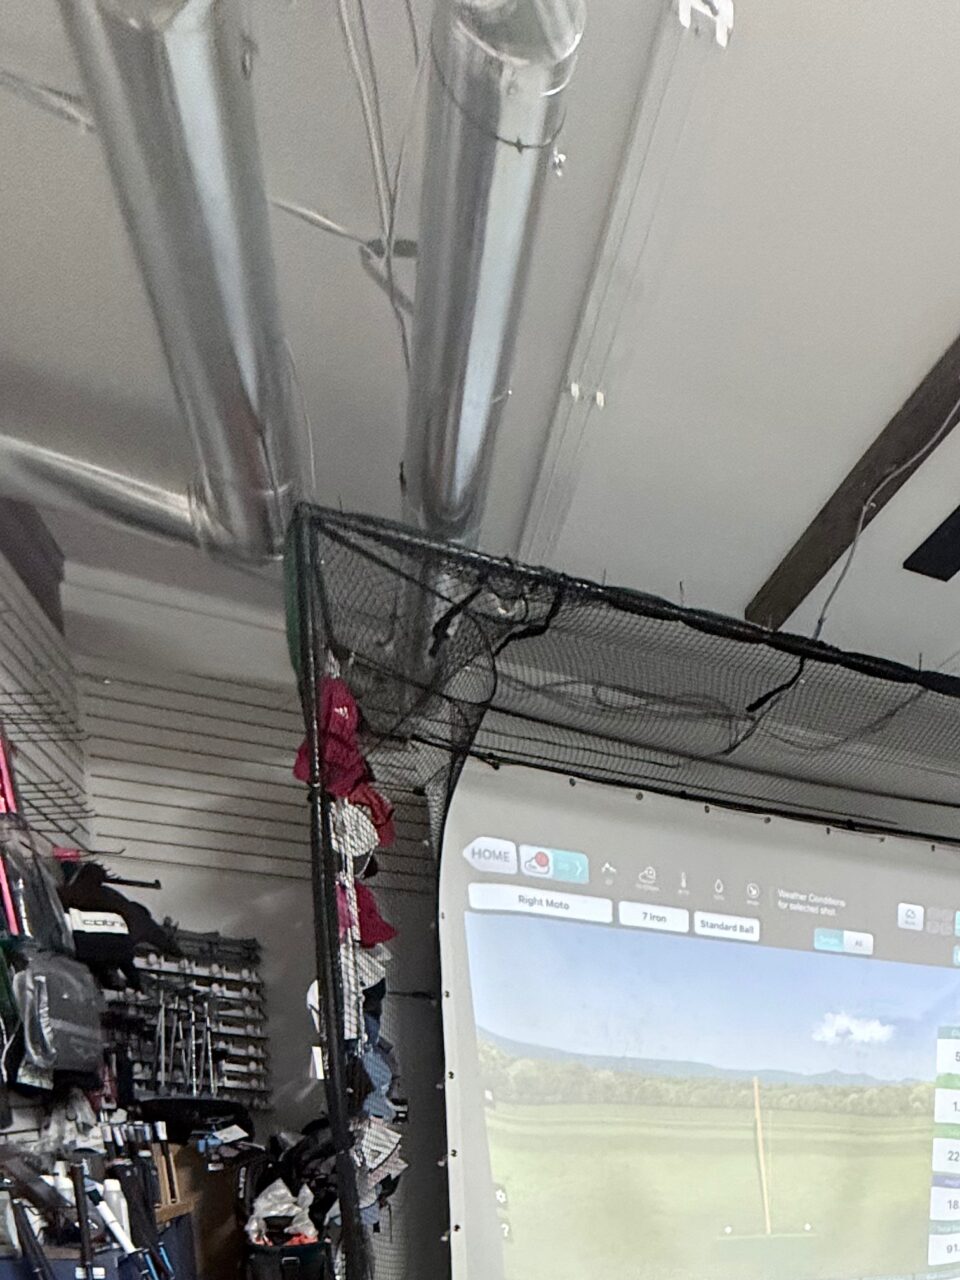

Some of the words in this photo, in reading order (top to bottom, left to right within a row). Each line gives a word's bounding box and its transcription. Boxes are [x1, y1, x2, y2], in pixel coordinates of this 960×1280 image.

[470, 848, 510, 863] HOME
[518, 894, 543, 909] Right
[544, 898, 570, 911] Moto
[642, 912, 649, 921] 7
[700, 919, 738, 933] Standard
[739, 923, 754, 935] Ball
